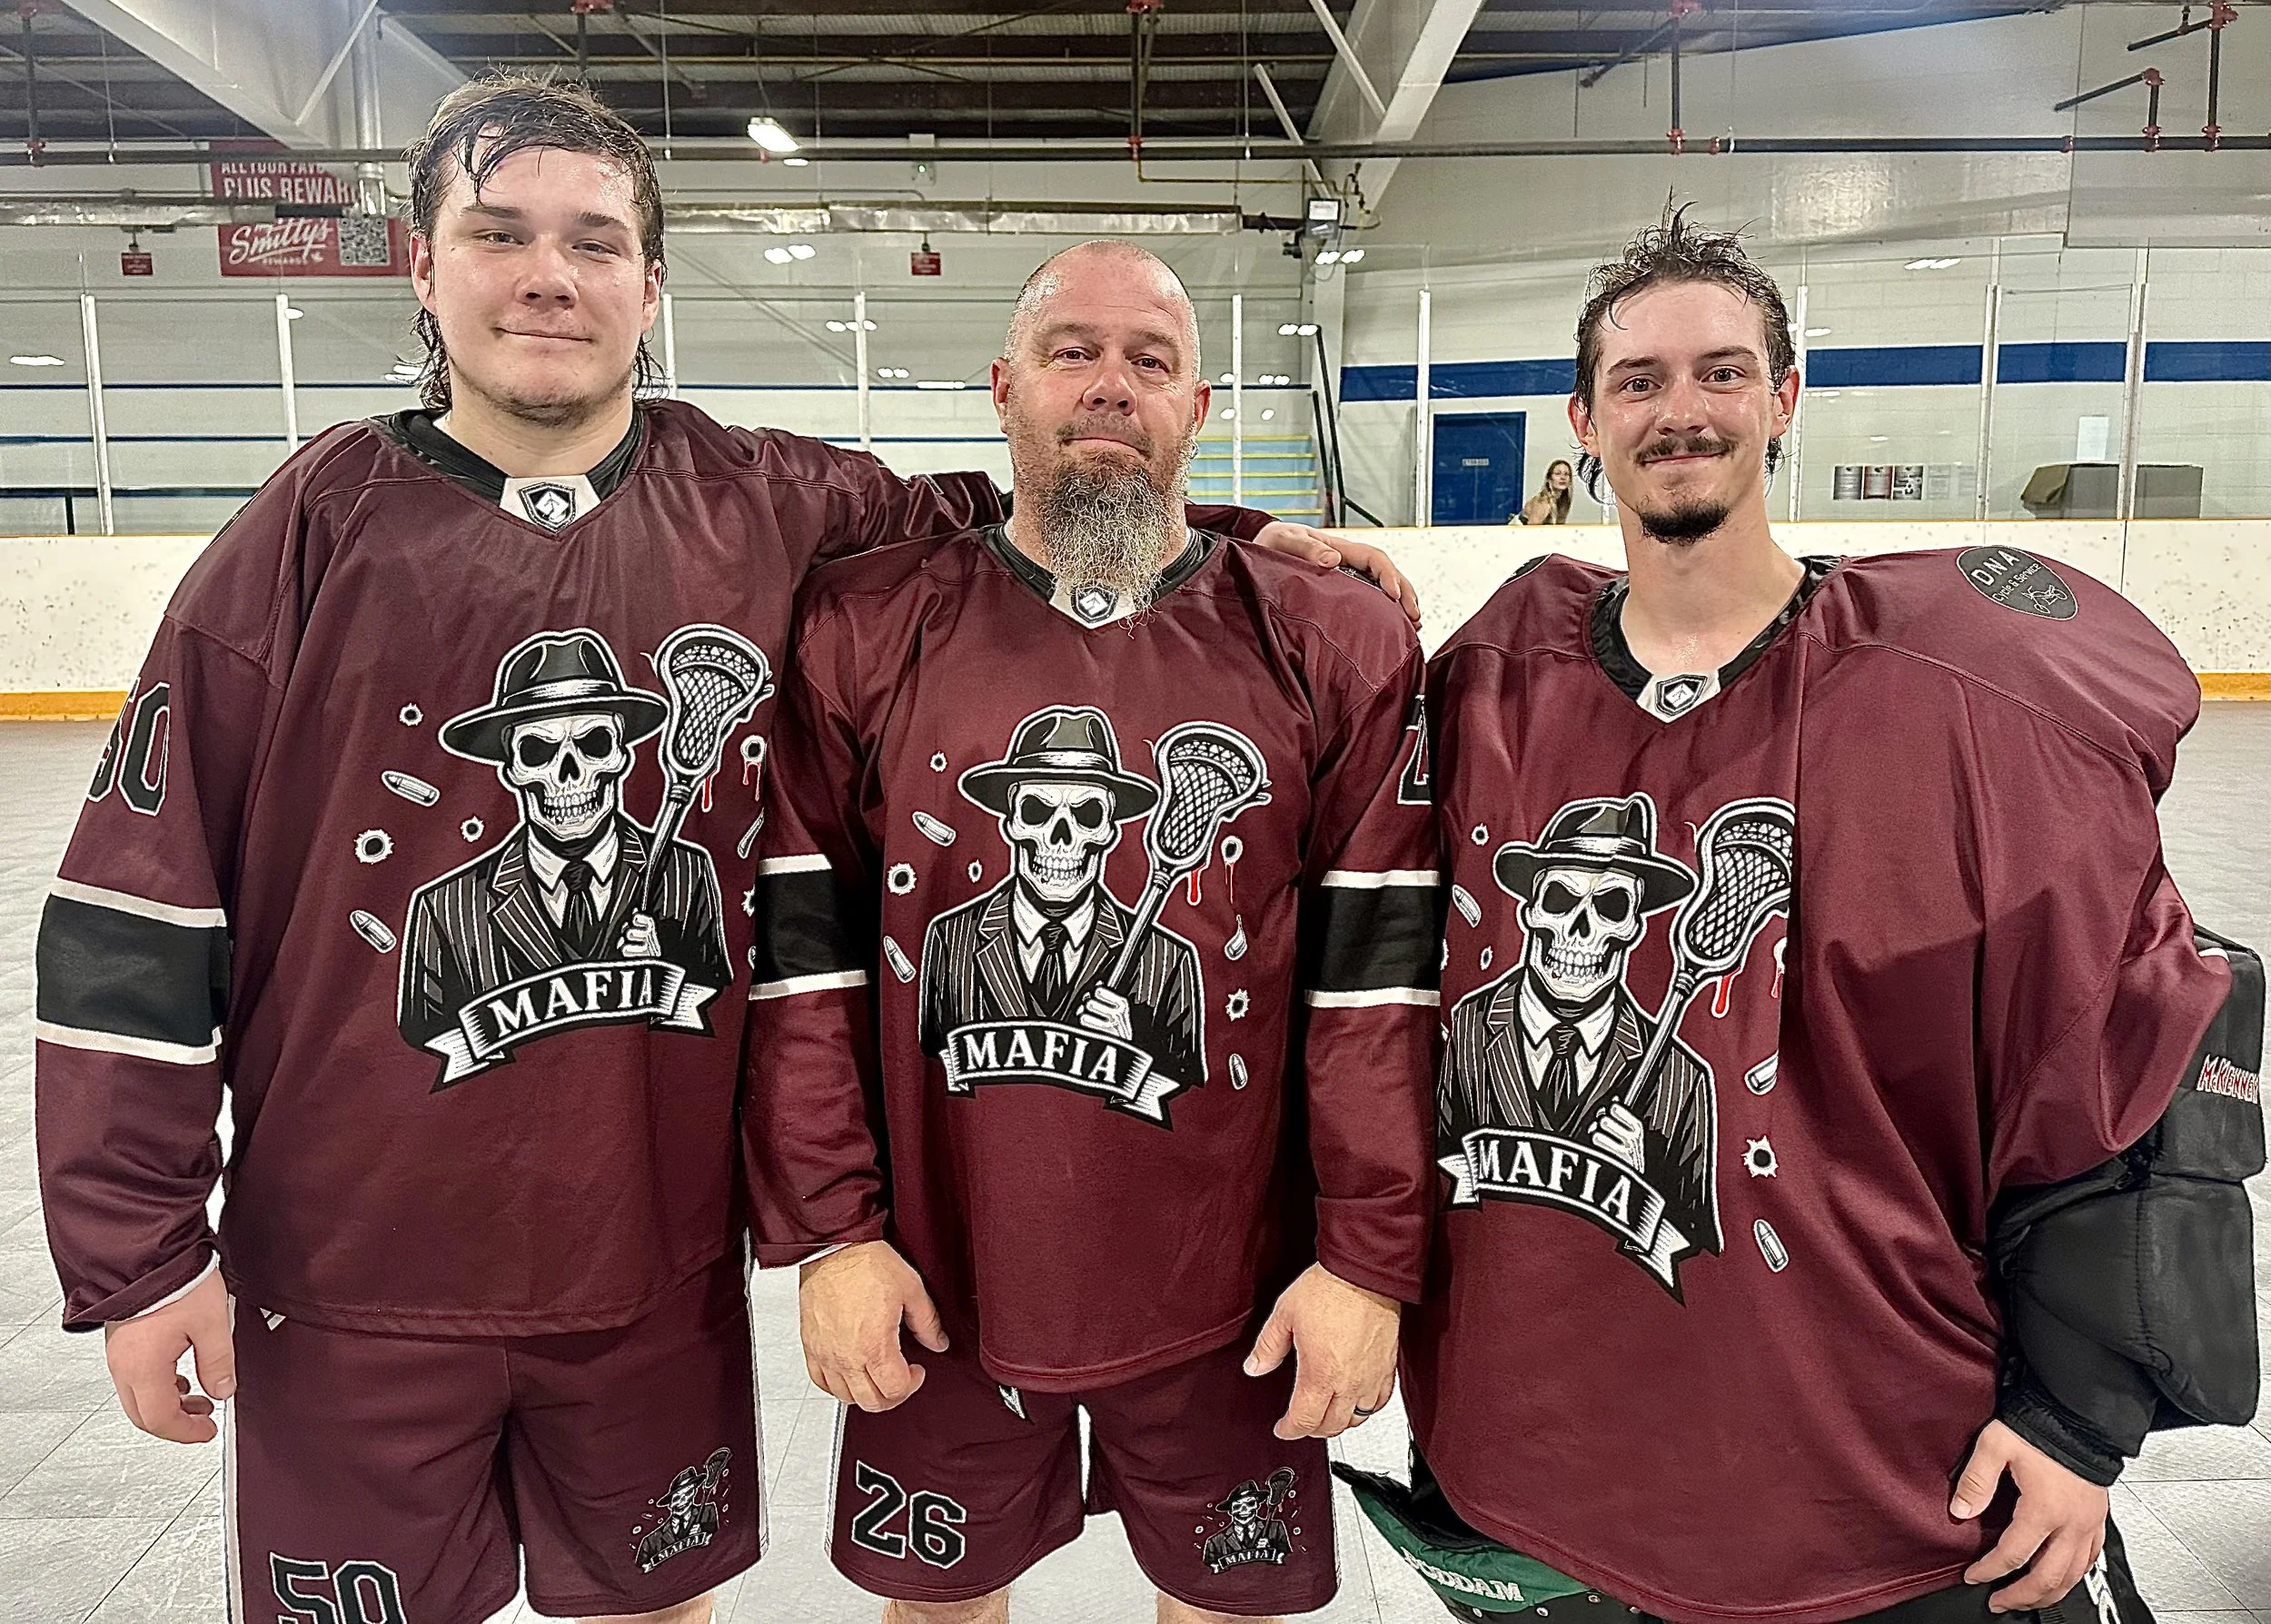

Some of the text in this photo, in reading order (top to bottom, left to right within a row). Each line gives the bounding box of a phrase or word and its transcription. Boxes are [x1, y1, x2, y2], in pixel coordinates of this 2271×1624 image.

[1970, 550, 2020, 587] DNA
[1991, 563, 2042, 602] Cycle & Service
[486, 967, 653, 1038] MAFIA
[963, 1028, 1118, 1084] MAFIA
[1478, 1139, 1631, 1225] MAFIA
[850, 1459, 967, 1570] 26
[269, 1551, 408, 1624] 50
[1225, 1549, 1268, 1565] MAFIA
